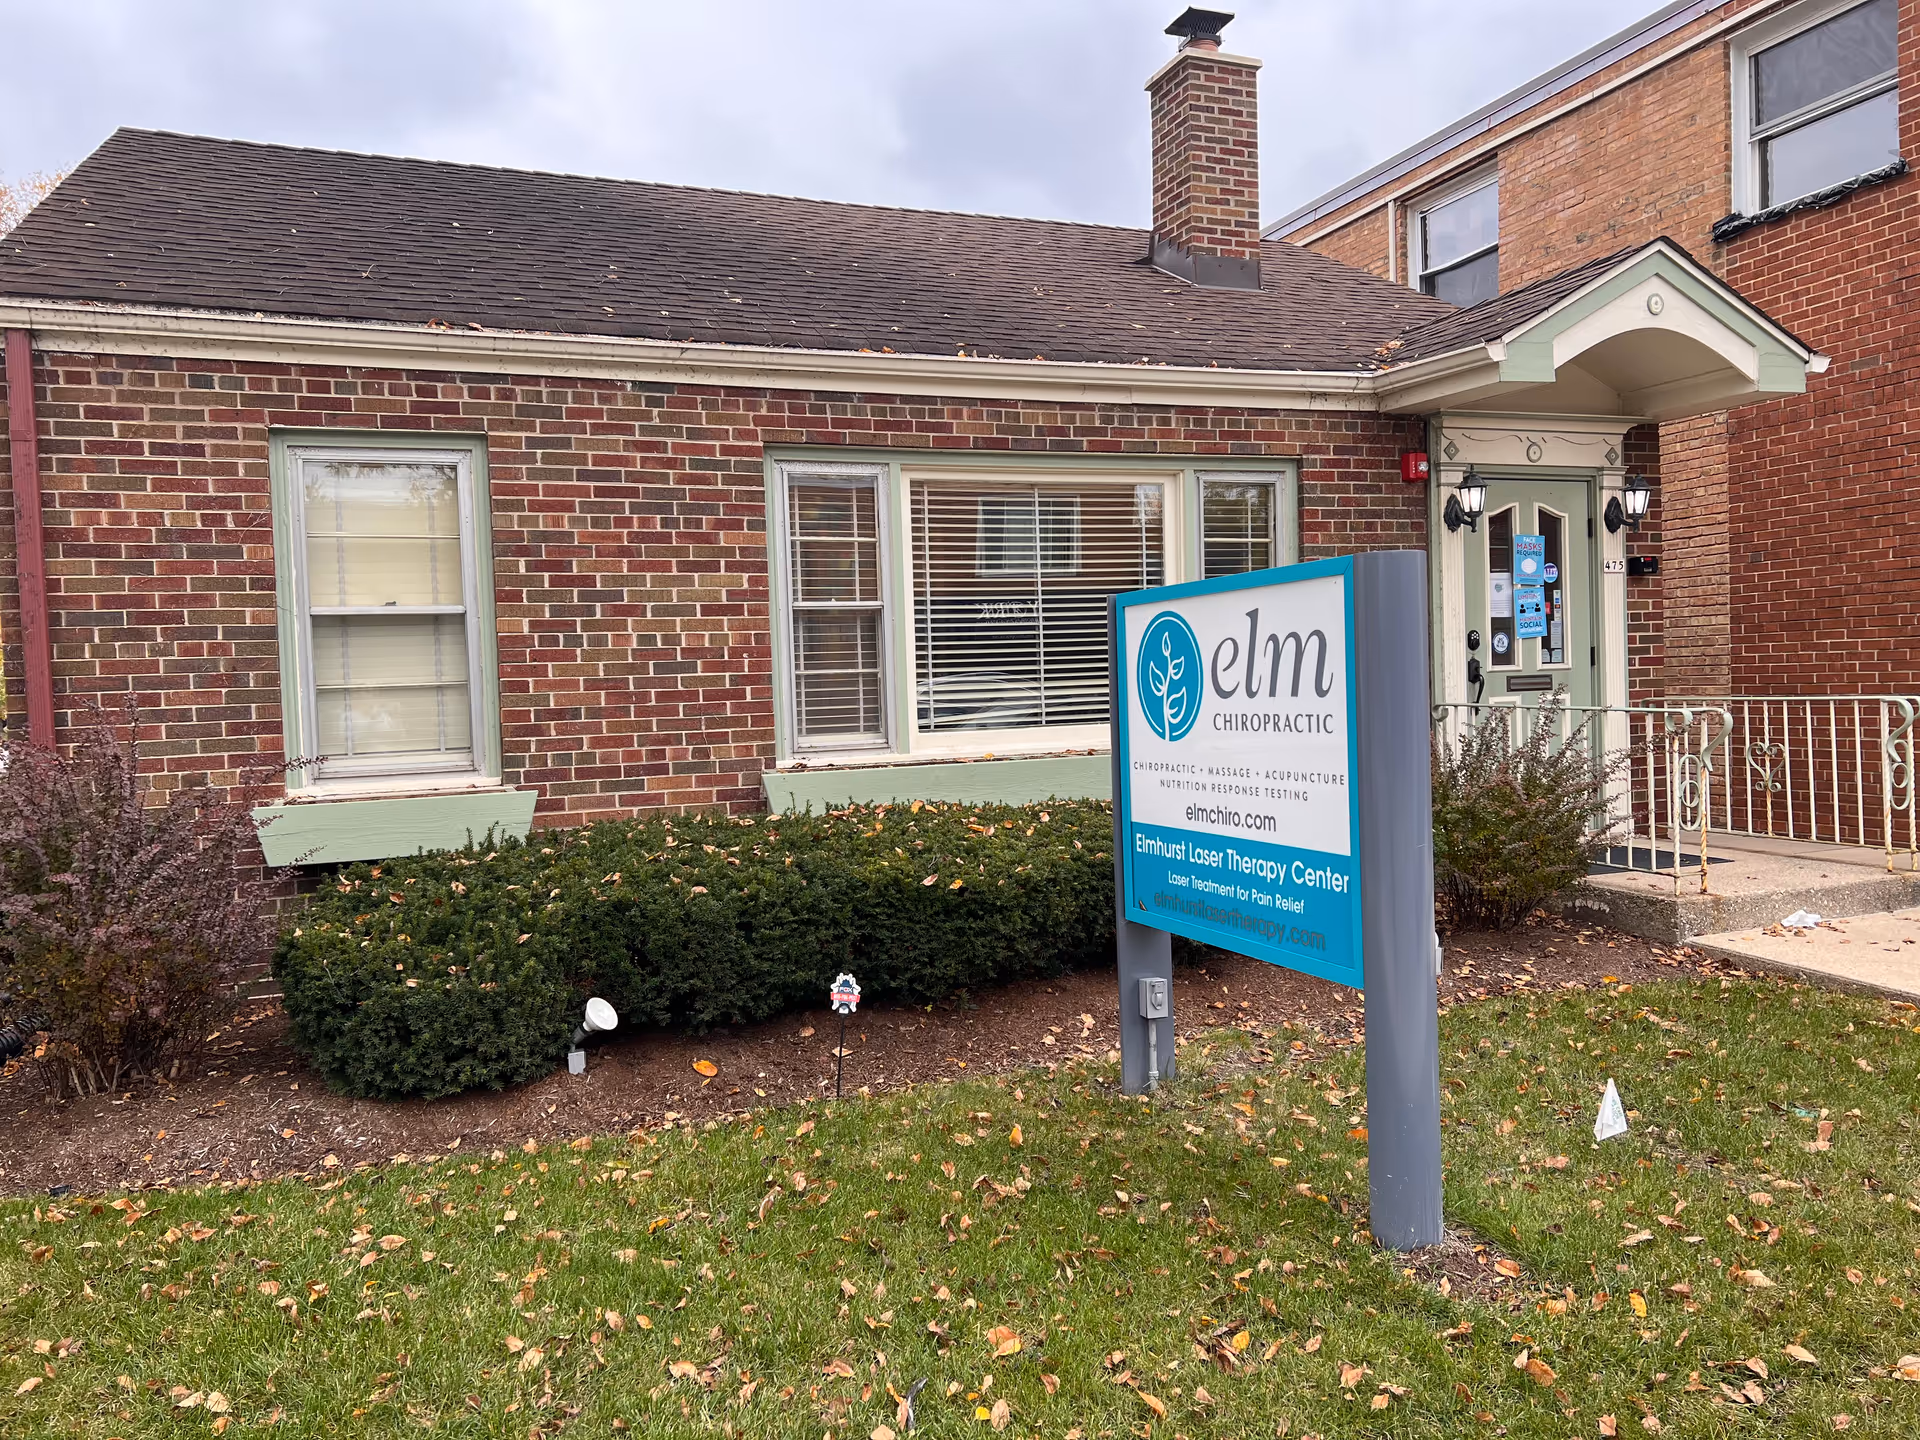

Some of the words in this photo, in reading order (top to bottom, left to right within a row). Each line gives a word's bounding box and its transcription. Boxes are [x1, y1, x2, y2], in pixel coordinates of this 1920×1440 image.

[1517, 543, 1542, 551] MASKS
[1605, 561, 1623, 570] 475
[1520, 621, 1543, 629] SOCIAL
[1211, 608, 1333, 699] elm
[1213, 713, 1334, 734] CHIROPRACTIC
[1133, 761, 1196, 775] CHIROPRACTIC
[1208, 766, 1251, 778] MASSAGE
[1265, 770, 1345, 786] ACUPUNCTURE
[1160, 779, 1207, 792] NUTRITION
[1211, 783, 1260, 797] RESPONSE
[1265, 788, 1308, 801] TESTING
[1185, 803, 1277, 832] elmchiro.com
[1136, 833, 1185, 860] Elmhurst
[1189, 842, 1223, 868] Laser
[1227, 849, 1287, 885] Therapy
[1291, 861, 1350, 893] Center
[1168, 871, 1190, 887] Laser
[1191, 876, 1235, 898] Treatment
[1236, 885, 1250, 902] for
[1252, 889, 1273, 907] Pain
[1276, 894, 1305, 914] Relief
[1154, 891, 1326, 950] elmhurstlasertherapy.com
